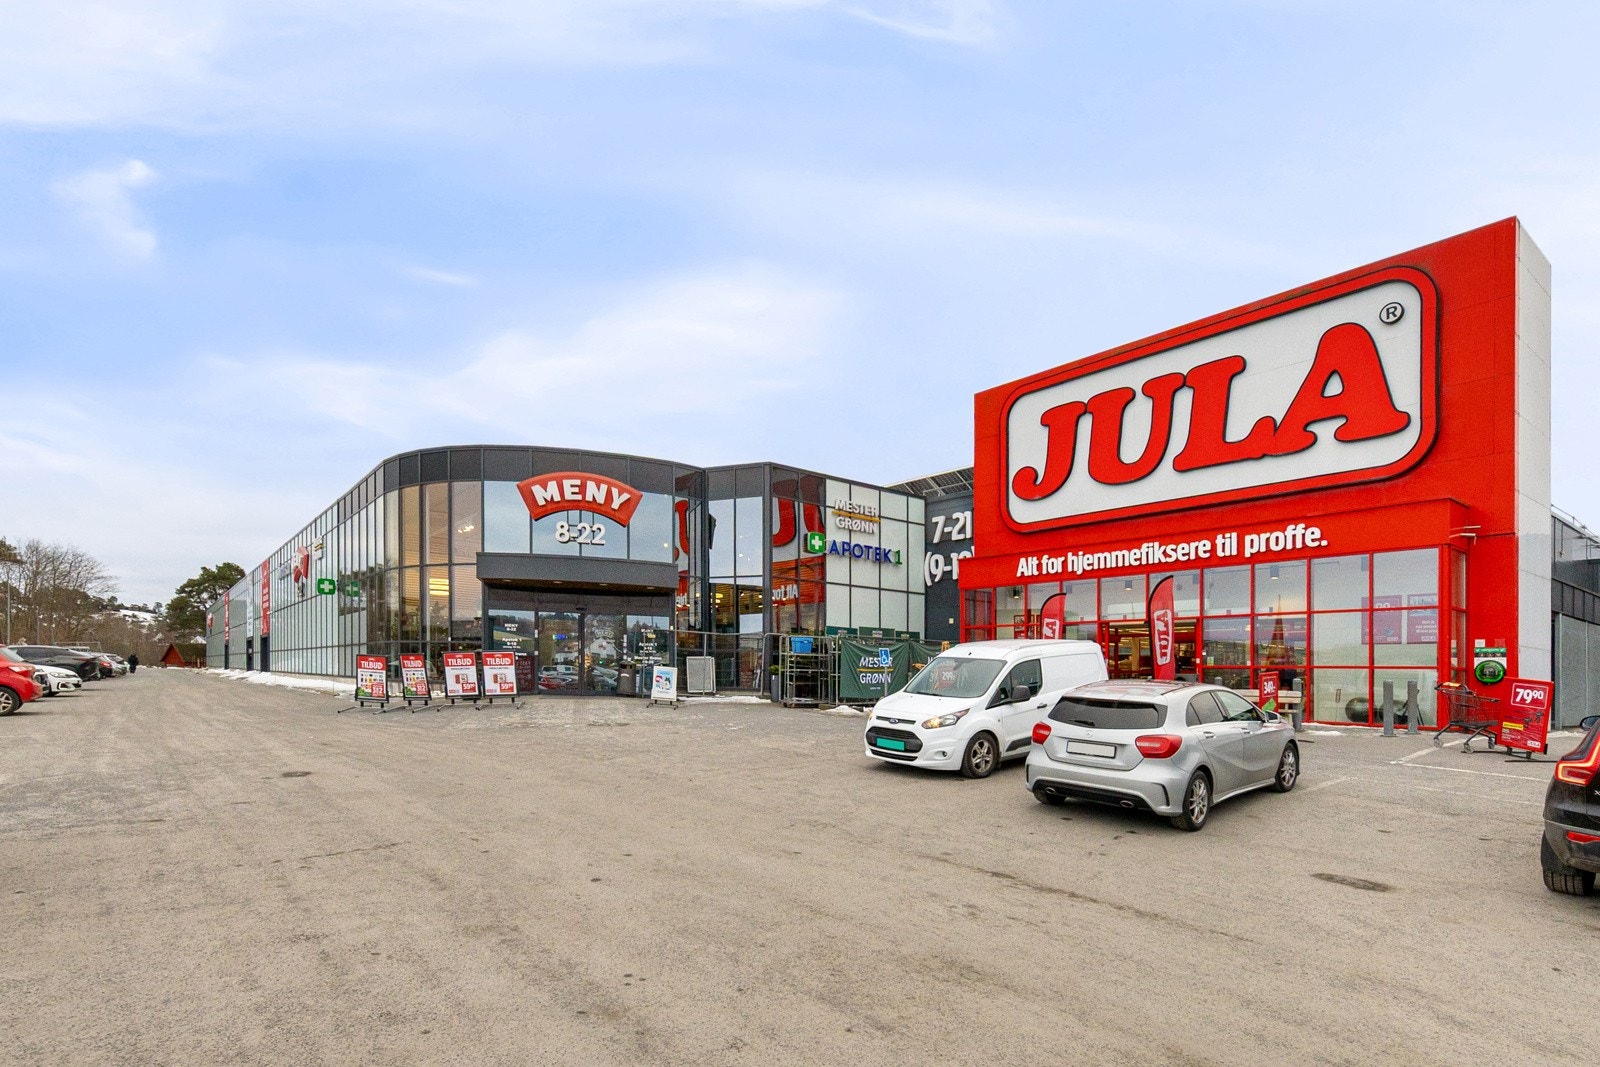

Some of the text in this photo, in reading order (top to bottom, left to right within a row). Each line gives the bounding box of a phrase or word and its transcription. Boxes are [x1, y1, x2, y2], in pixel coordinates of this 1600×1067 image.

[1012, 322, 1411, 501] JULA
[531, 479, 631, 511] MENY
[835, 499, 878, 517] MESTER
[555, 520, 606, 546] 8-22
[836, 516, 878, 535] GRØNN
[932, 510, 973, 544] 7-21
[829, 539, 903, 566] APOTEK 1
[1016, 523, 1329, 578] Alt for hjemmefiksere til proffe.
[1156, 610, 1170, 662] JULA
[360, 660, 383, 670] TILBUD
[403, 659, 423, 668] TILBUD
[447, 658, 473, 666] TILBUD
[485, 657, 511, 665] TILBUD
[859, 656, 893, 668] MESR
